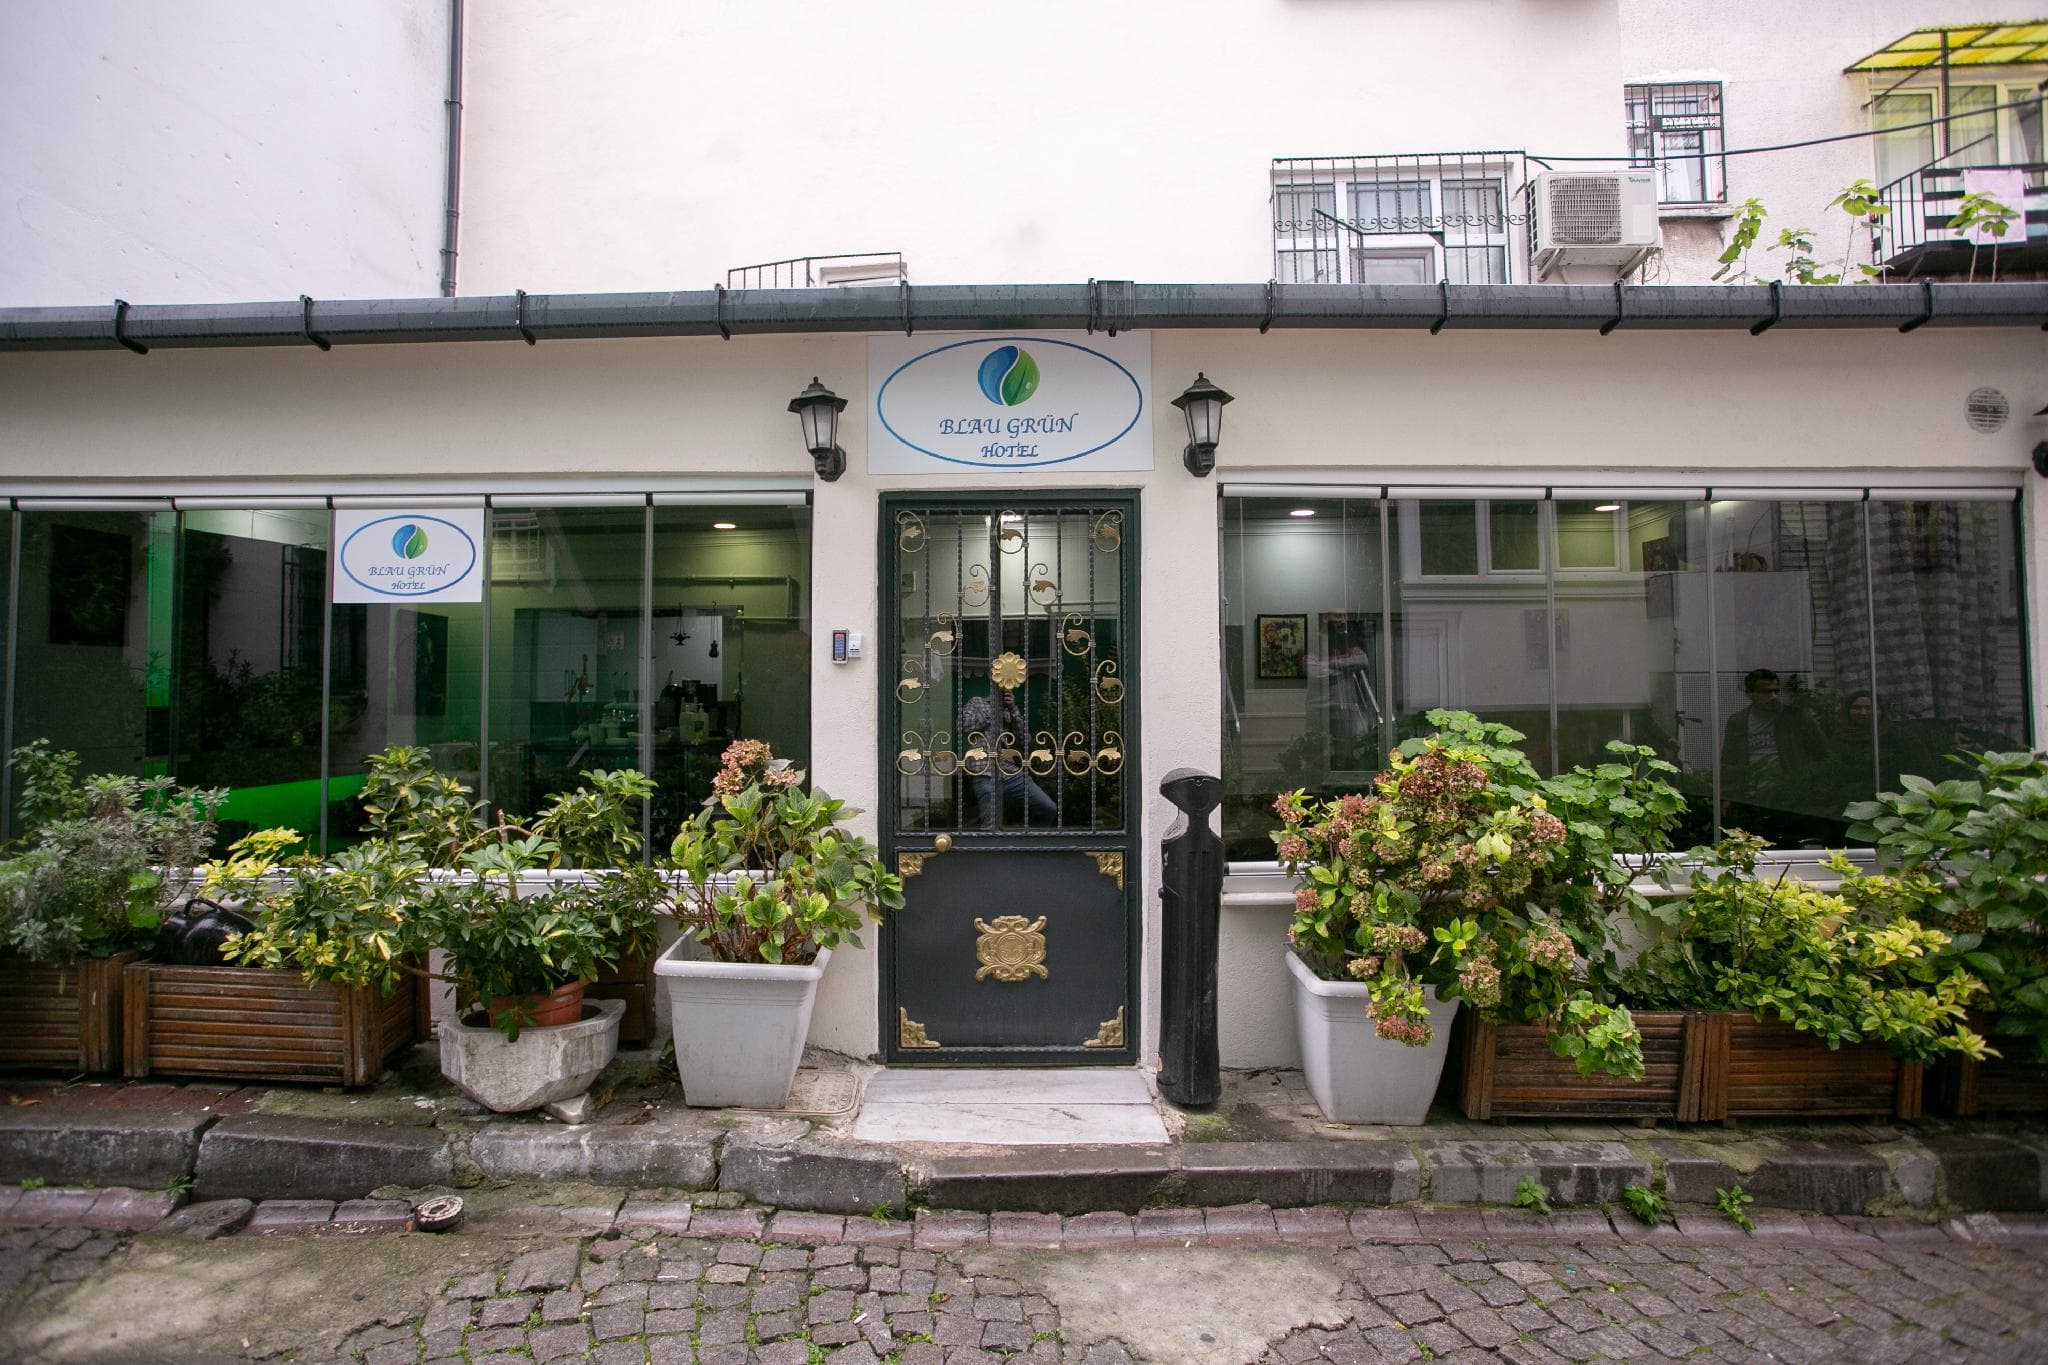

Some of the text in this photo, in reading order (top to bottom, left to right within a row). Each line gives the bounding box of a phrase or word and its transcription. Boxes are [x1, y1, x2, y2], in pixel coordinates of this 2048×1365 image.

[939, 413, 1079, 438] BLAU GRÜN
[980, 442, 1039, 458] HOTEL
[368, 563, 450, 579] BLAU GRÜN
[391, 580, 426, 590] HOTEL
